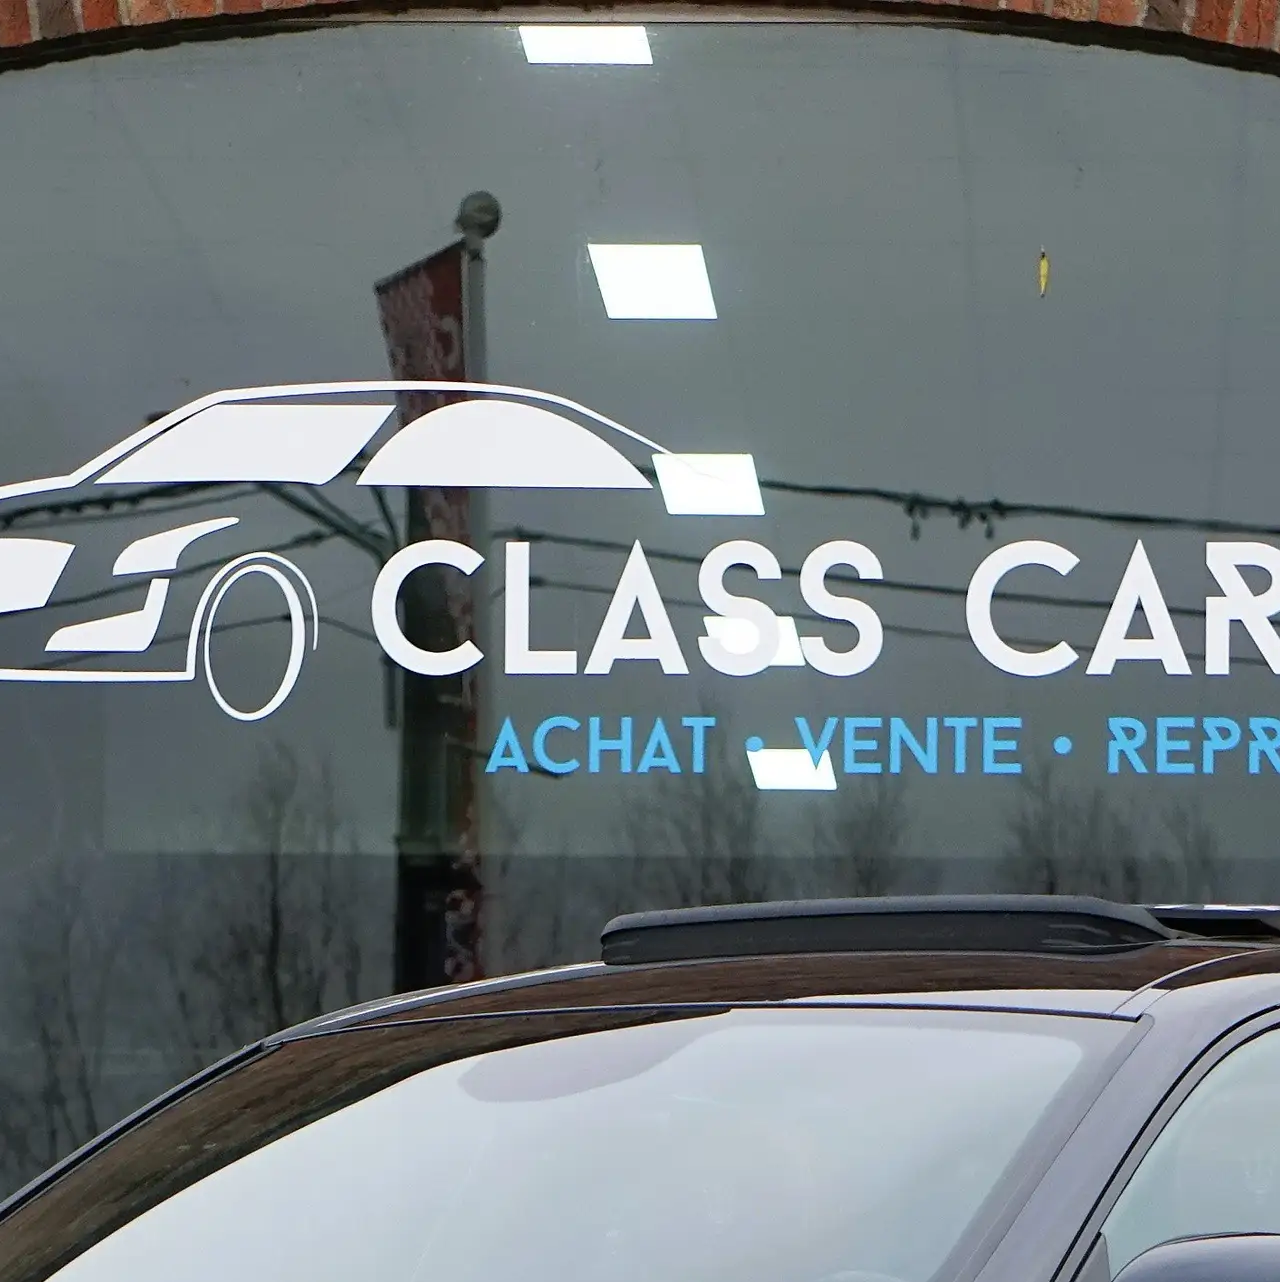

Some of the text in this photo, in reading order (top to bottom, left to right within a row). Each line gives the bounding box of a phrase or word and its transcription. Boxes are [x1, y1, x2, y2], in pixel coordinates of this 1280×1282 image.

[371, 539, 884, 676] CLASS
[486, 716, 716, 774] ACHAT
[795, 717, 1022, 774] VENTE
